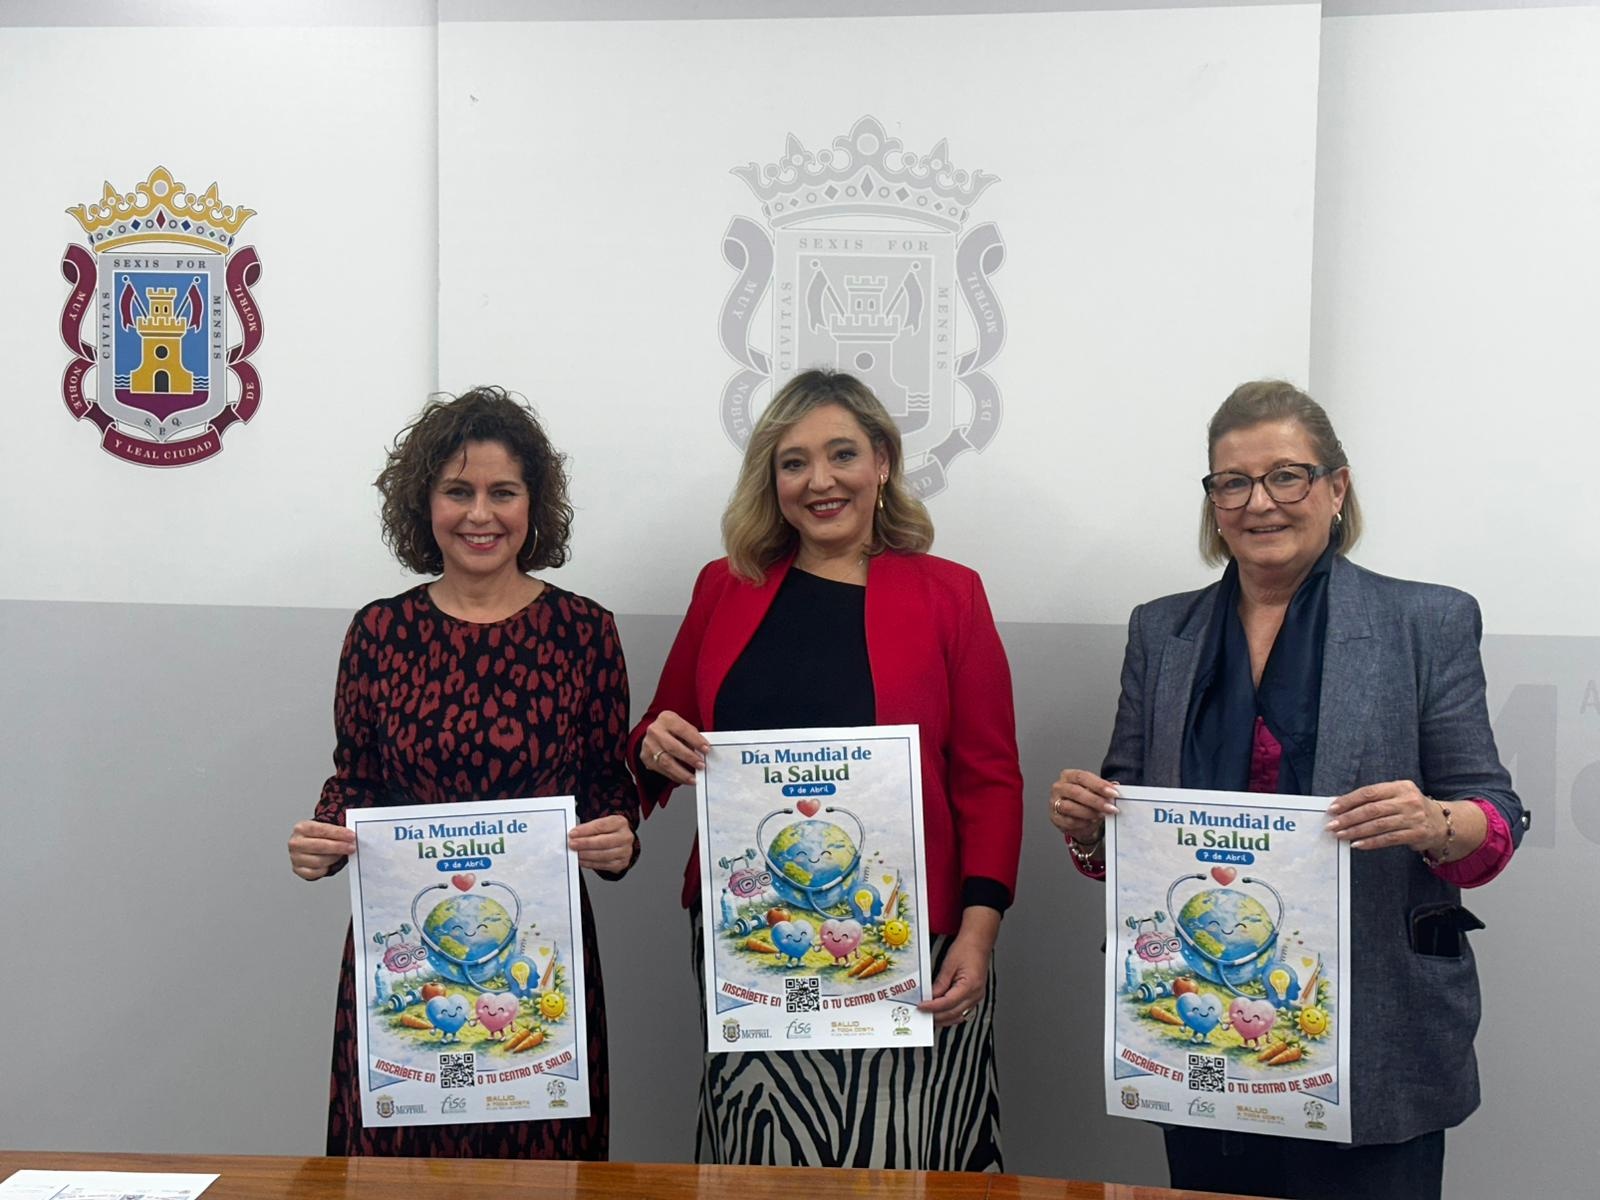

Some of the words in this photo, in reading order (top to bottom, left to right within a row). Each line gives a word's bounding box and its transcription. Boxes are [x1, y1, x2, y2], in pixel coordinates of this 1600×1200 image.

[800, 238, 864, 249] SEXIS
[889, 240, 929, 251] FOR
[114, 259, 160, 268] SEXIS
[176, 260, 206, 269] FOR
[69, 291, 86, 320] MUY
[236, 284, 257, 332] MOTRIL
[732, 280, 758, 320] MUY
[967, 272, 998, 334] MOTRIL
[213, 296, 221, 360] MENSIS
[780, 281, 792, 371] CIVITAS
[937, 287, 948, 370] MENSIS
[69, 367, 82, 410] NOBLE
[246, 382, 254, 400] DE
[981, 398, 992, 422] DE
[114, 439, 123, 448] Y
[127, 444, 159, 460] LEAL
[164, 440, 212, 459] CIUDAD
[741, 750, 770, 765] Día
[774, 747, 848, 764] Mundial
[851, 747, 872, 761] de
[763, 767, 782, 783] la
[788, 764, 850, 783] Salud
[394, 825, 424, 841] Día
[429, 820, 503, 838] Mundial
[507, 819, 528, 834] de
[1154, 808, 1184, 824] Día
[1190, 810, 1269, 830] Mundial
[1273, 816, 1296, 832] de
[418, 842, 437, 859] la
[442, 837, 506, 858] Salud
[1177, 828, 1197, 846] la
[1203, 829, 1270, 851] Salud
[465, 860, 484, 868] Abril
[1225, 854, 1246, 862] Abril
[722, 982, 768, 1004] INSCRÍBETE
[823, 1000, 829, 1009] O
[831, 998, 841, 1009] TU
[844, 993, 876, 1007] CENTRO
[877, 989, 889, 1000] DE
[890, 978, 917, 996] SALUD
[375, 1058, 423, 1081] INSCRÍBETE
[478, 1075, 483, 1084] O
[486, 1074, 496, 1084] TU
[499, 1067, 531, 1082] CENTRO
[532, 1063, 545, 1074] DE
[545, 1051, 572, 1069] SALUD
[1121, 1048, 1170, 1078] INSCRÍBETE
[1228, 1082, 1234, 1092] O
[1237, 1083, 1248, 1093] TU
[1251, 1082, 1286, 1094] CENTRO
[1288, 1080, 1301, 1092] DE
[1303, 1073, 1333, 1089] SALUD
